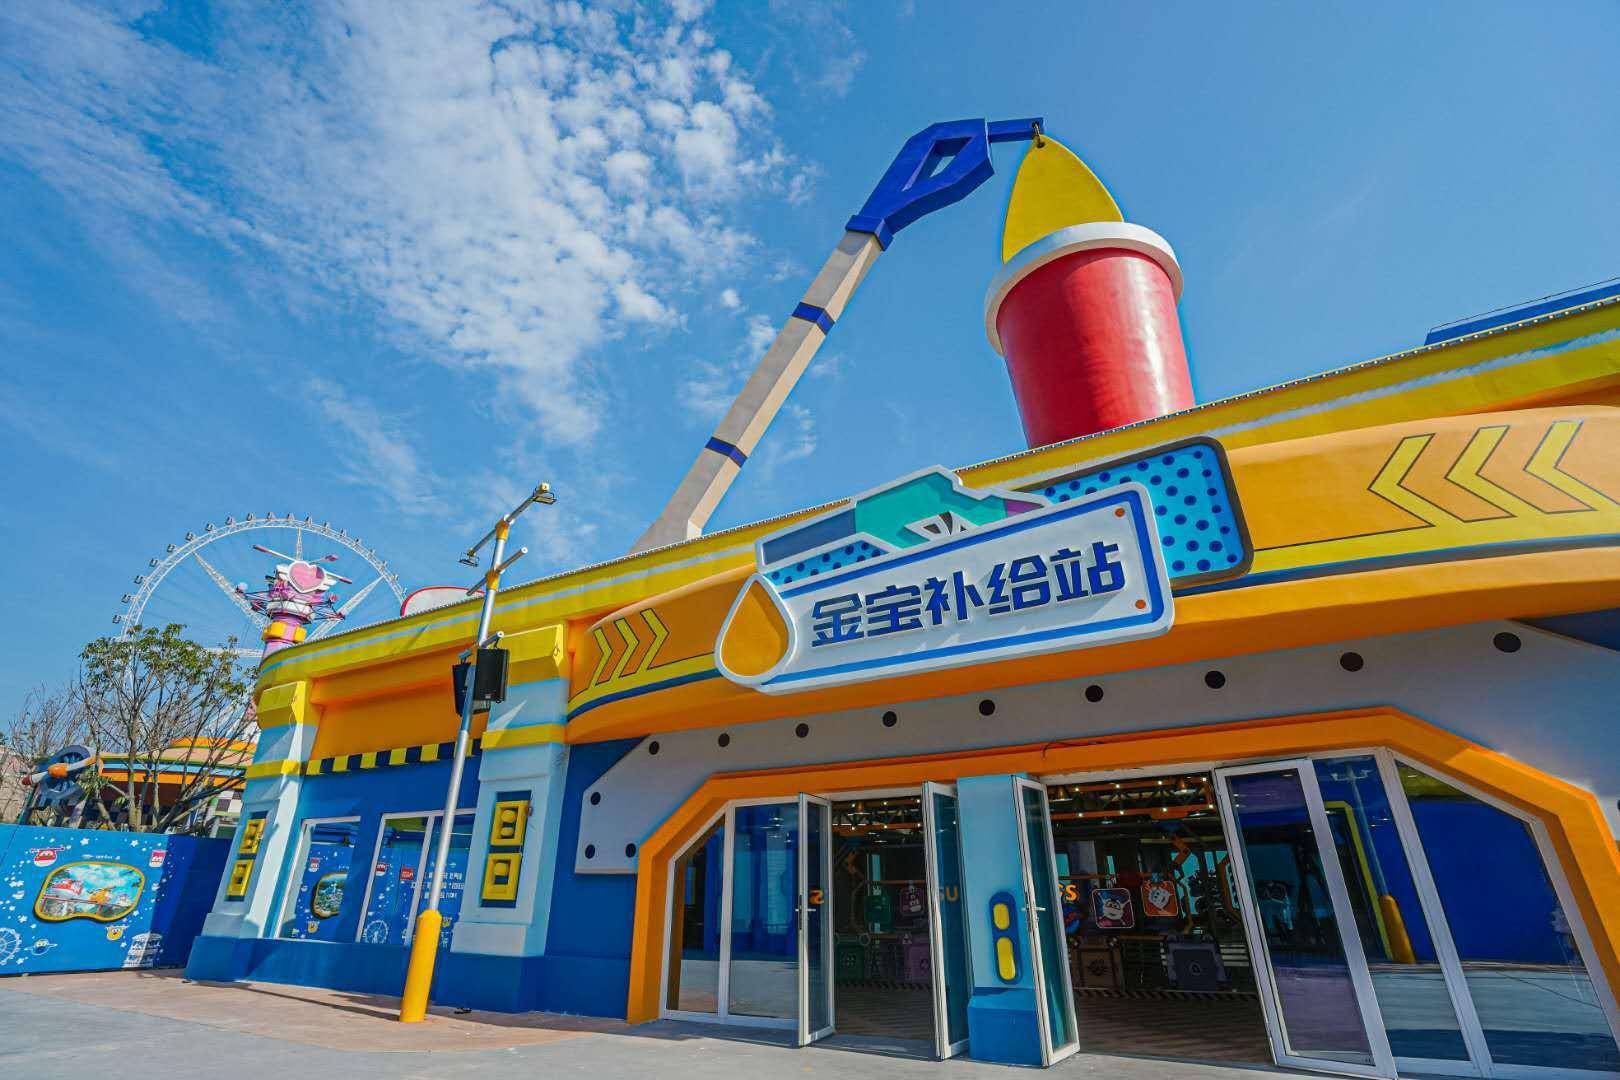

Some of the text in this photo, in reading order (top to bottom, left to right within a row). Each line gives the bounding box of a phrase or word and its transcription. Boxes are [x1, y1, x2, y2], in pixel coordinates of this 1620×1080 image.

[811, 541, 1125, 646] 金宝补给站
